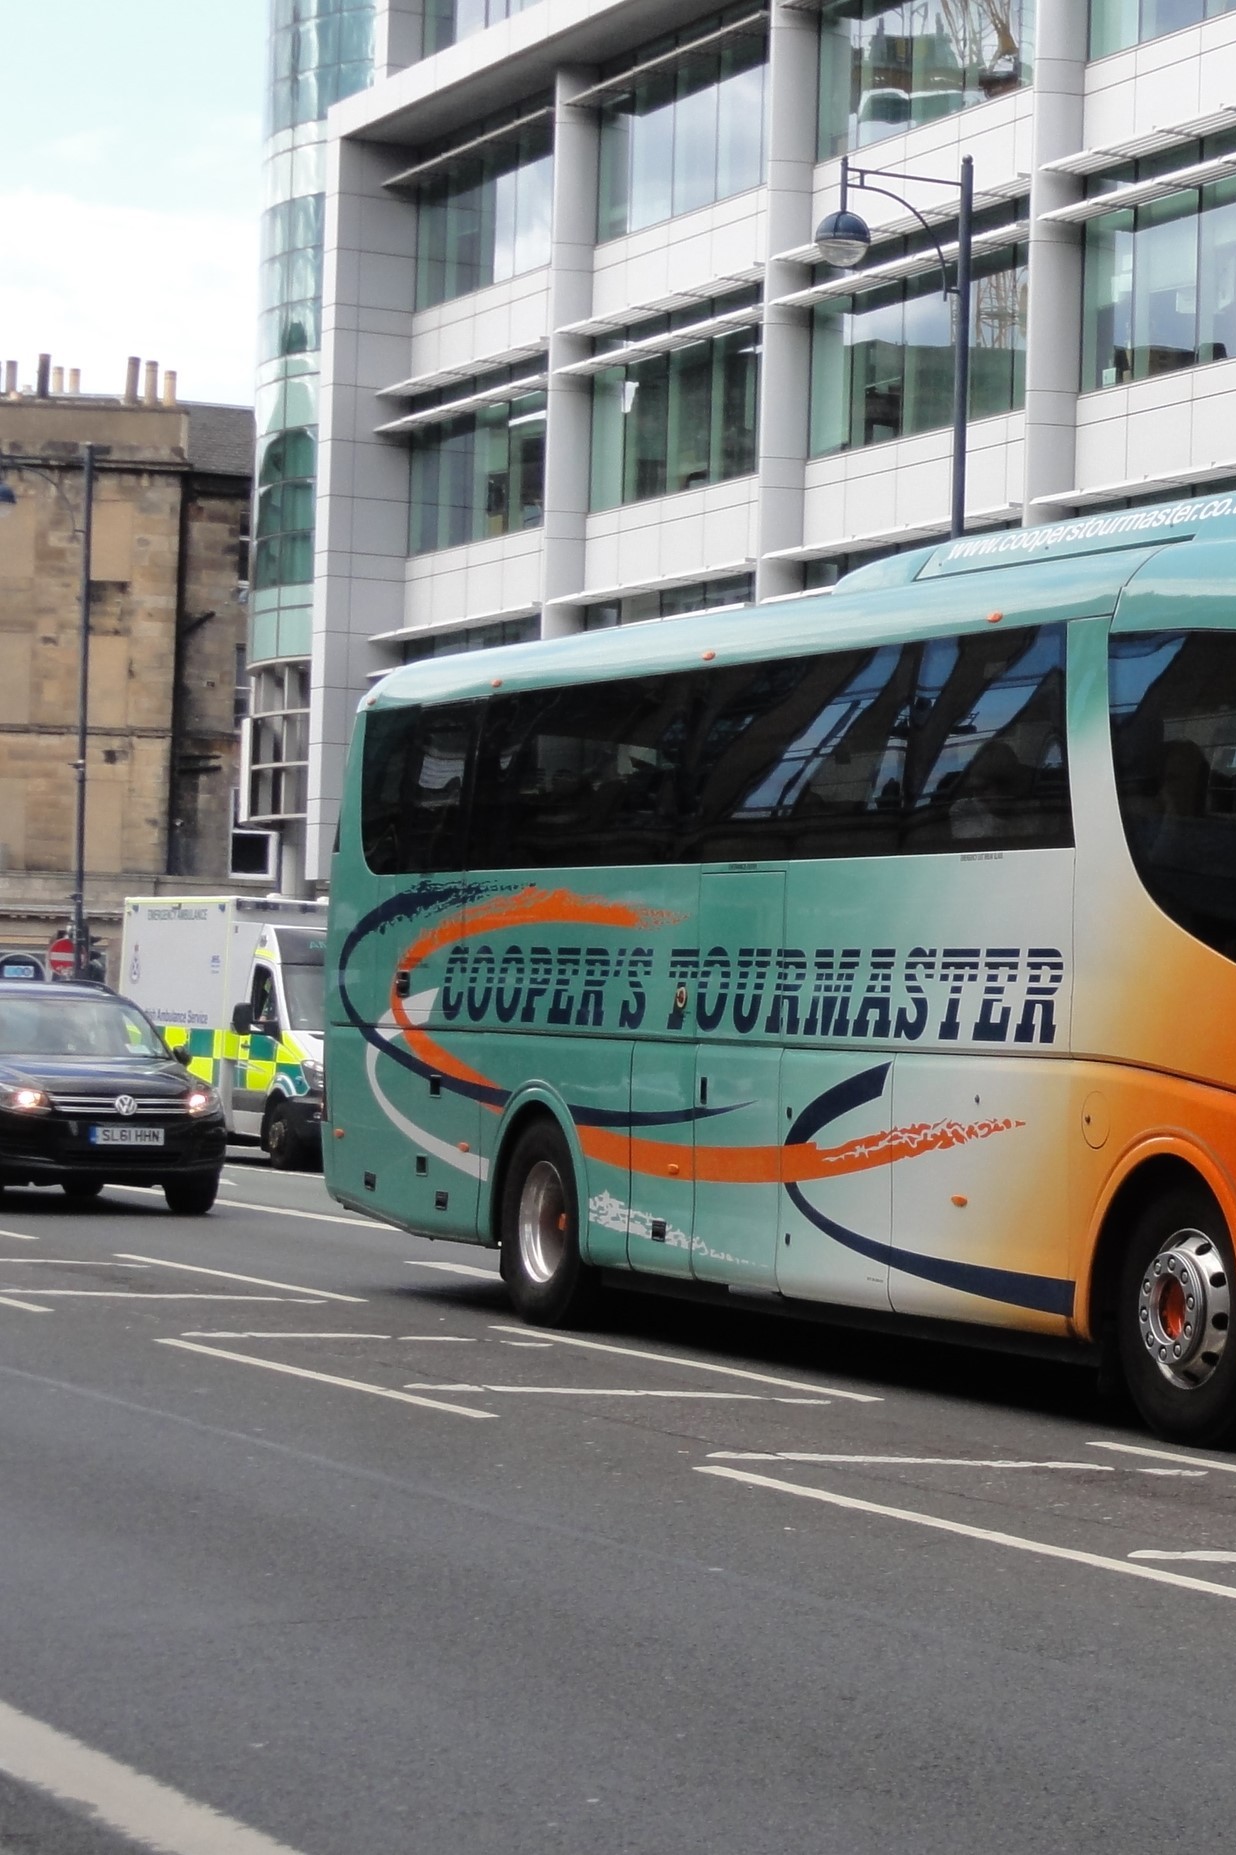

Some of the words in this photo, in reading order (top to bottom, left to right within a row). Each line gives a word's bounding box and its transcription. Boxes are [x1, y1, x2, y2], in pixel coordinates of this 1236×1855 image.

[441, 945, 654, 1031] COOPER'S
[667, 946, 1065, 1044] TOURMASTER
[187, 1010, 208, 1025] Service
[102, 1129, 132, 1142] SL61
[135, 1130, 160, 1142] HHN
